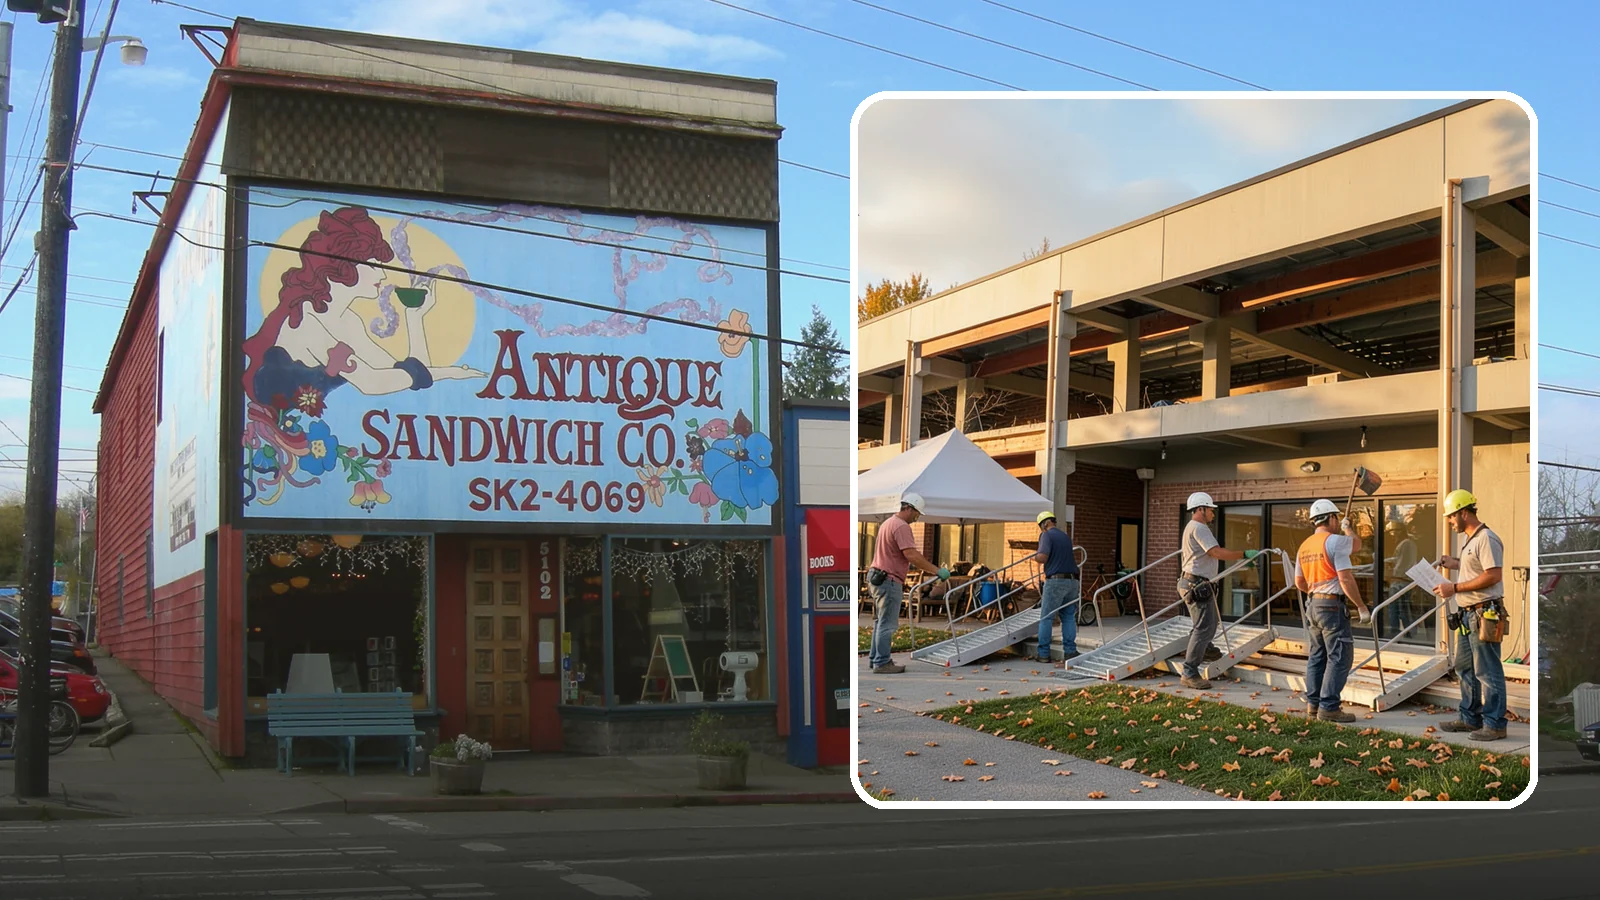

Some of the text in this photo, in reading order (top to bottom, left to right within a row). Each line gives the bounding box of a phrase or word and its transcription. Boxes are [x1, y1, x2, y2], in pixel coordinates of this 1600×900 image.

[477, 329, 724, 421] ANTIQUE
[361, 409, 686, 469] SANDWICH CO.
[468, 477, 646, 513] SK2-4069
[540, 541, 552, 599] 5102
[810, 555, 834, 568] BOOKS
